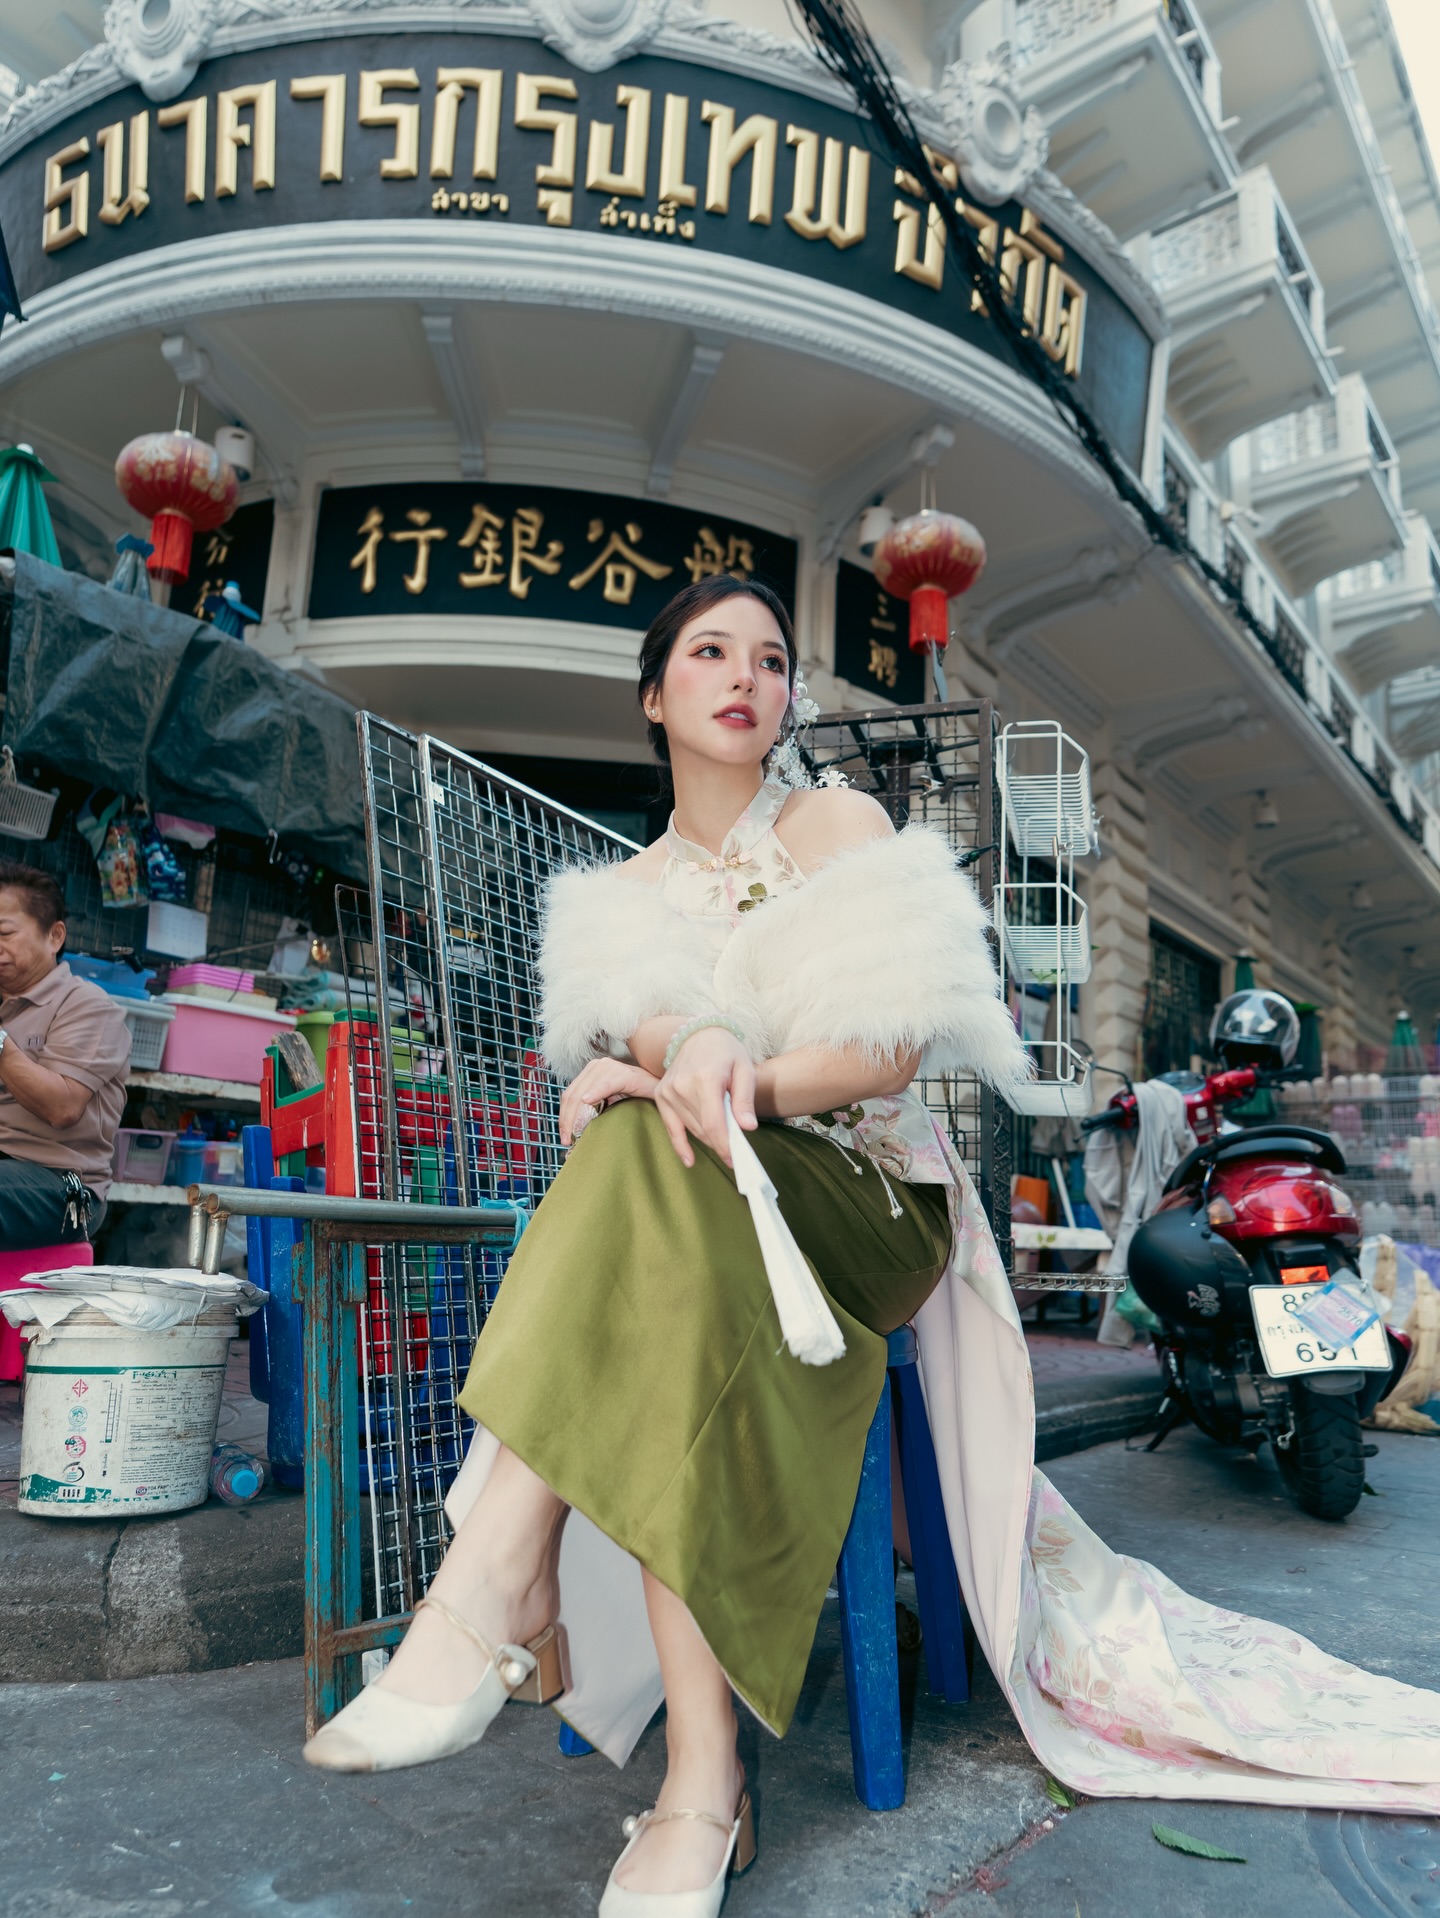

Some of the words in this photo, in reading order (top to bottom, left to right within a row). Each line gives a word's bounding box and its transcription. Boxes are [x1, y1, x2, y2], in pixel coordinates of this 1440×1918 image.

[42, 66, 872, 253] ธนาคารกรุงเทพ
[431, 187, 509, 213] สาขา
